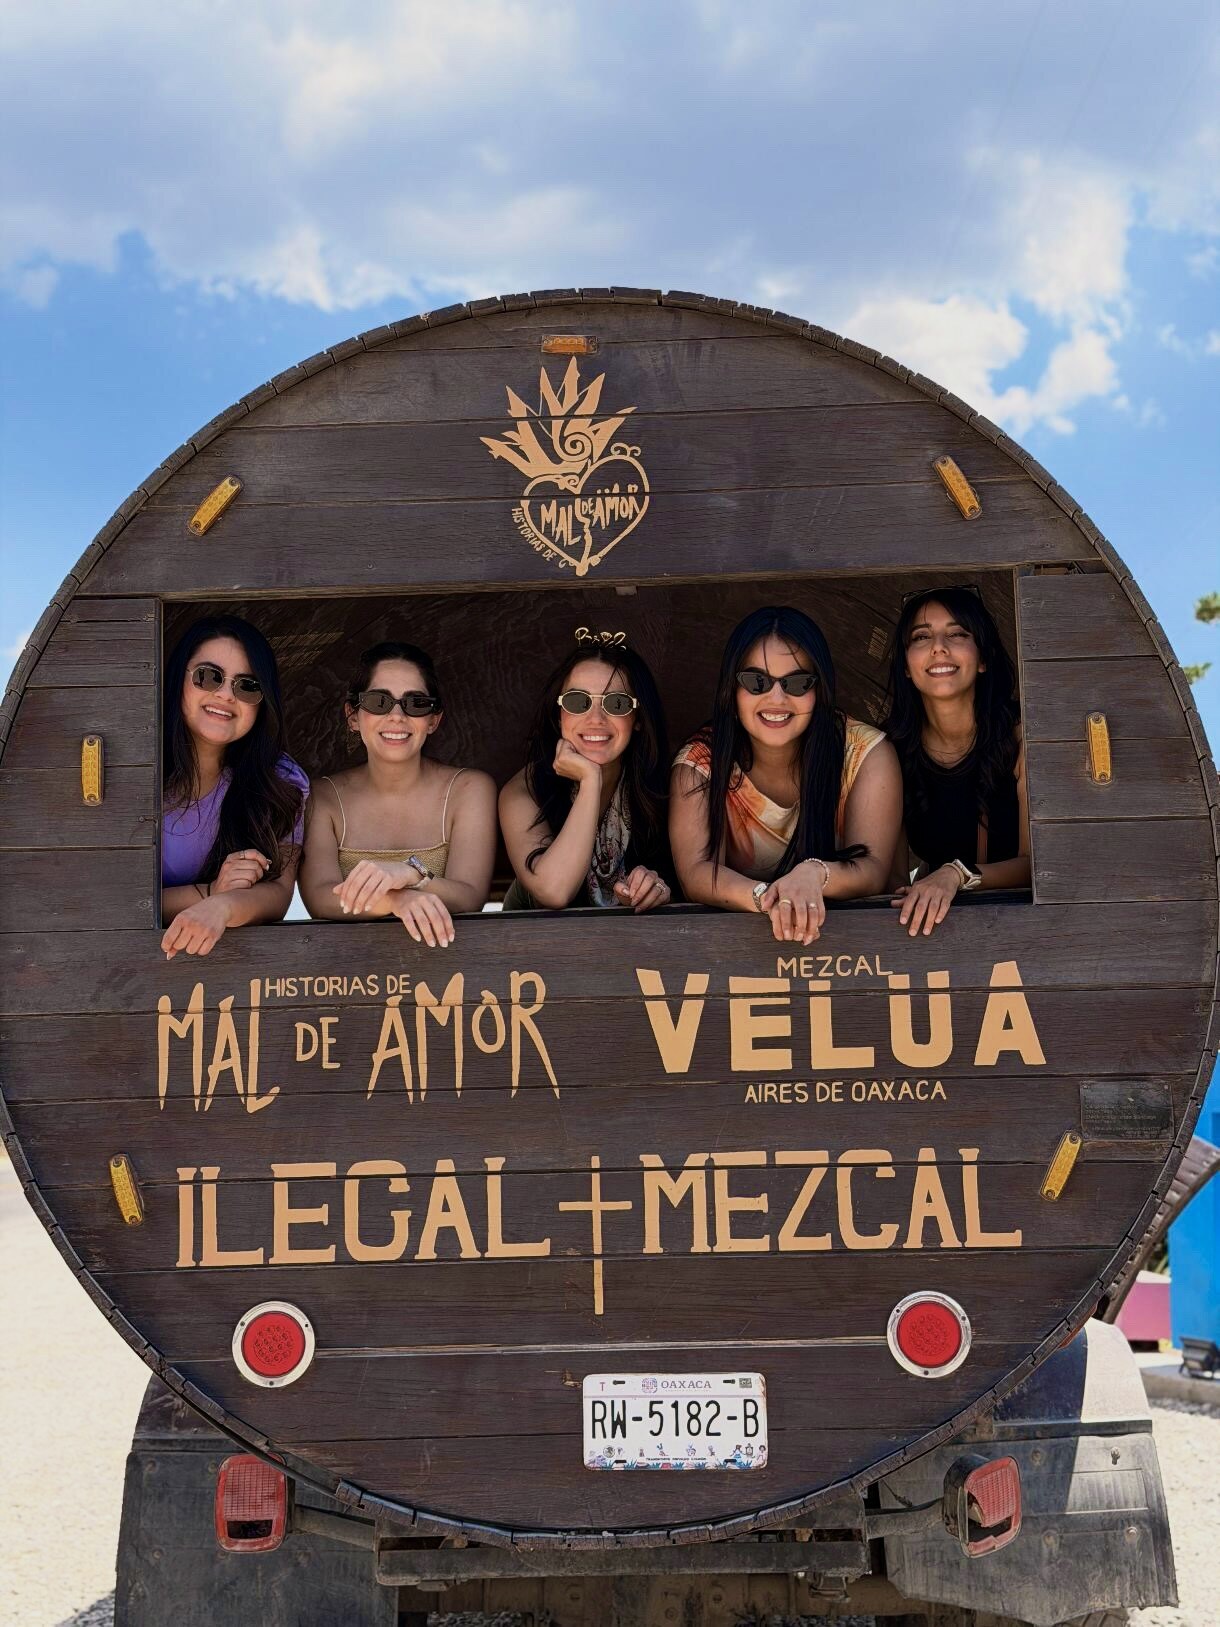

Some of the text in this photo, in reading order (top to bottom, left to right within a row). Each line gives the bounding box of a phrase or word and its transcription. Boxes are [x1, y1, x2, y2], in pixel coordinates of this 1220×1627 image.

[511, 507, 557, 562] HISTORIAS DE
[540, 483, 640, 548] MAL DE AMOR
[264, 974, 412, 999] HISTORIAS DE
[776, 954, 894, 978] MEZCAL
[635, 960, 1048, 1074] VELUA
[157, 971, 561, 1114] MAL DE AMOR
[744, 1079, 947, 1104] AIRES DE OAXACA
[175, 1156, 552, 1268] ILEGAL
[638, 1147, 1023, 1254] MEZCAL
[599, 1381, 606, 1392] T
[660, 1380, 712, 1389] OAXACA
[591, 1398, 760, 1439] RW-5182-B
